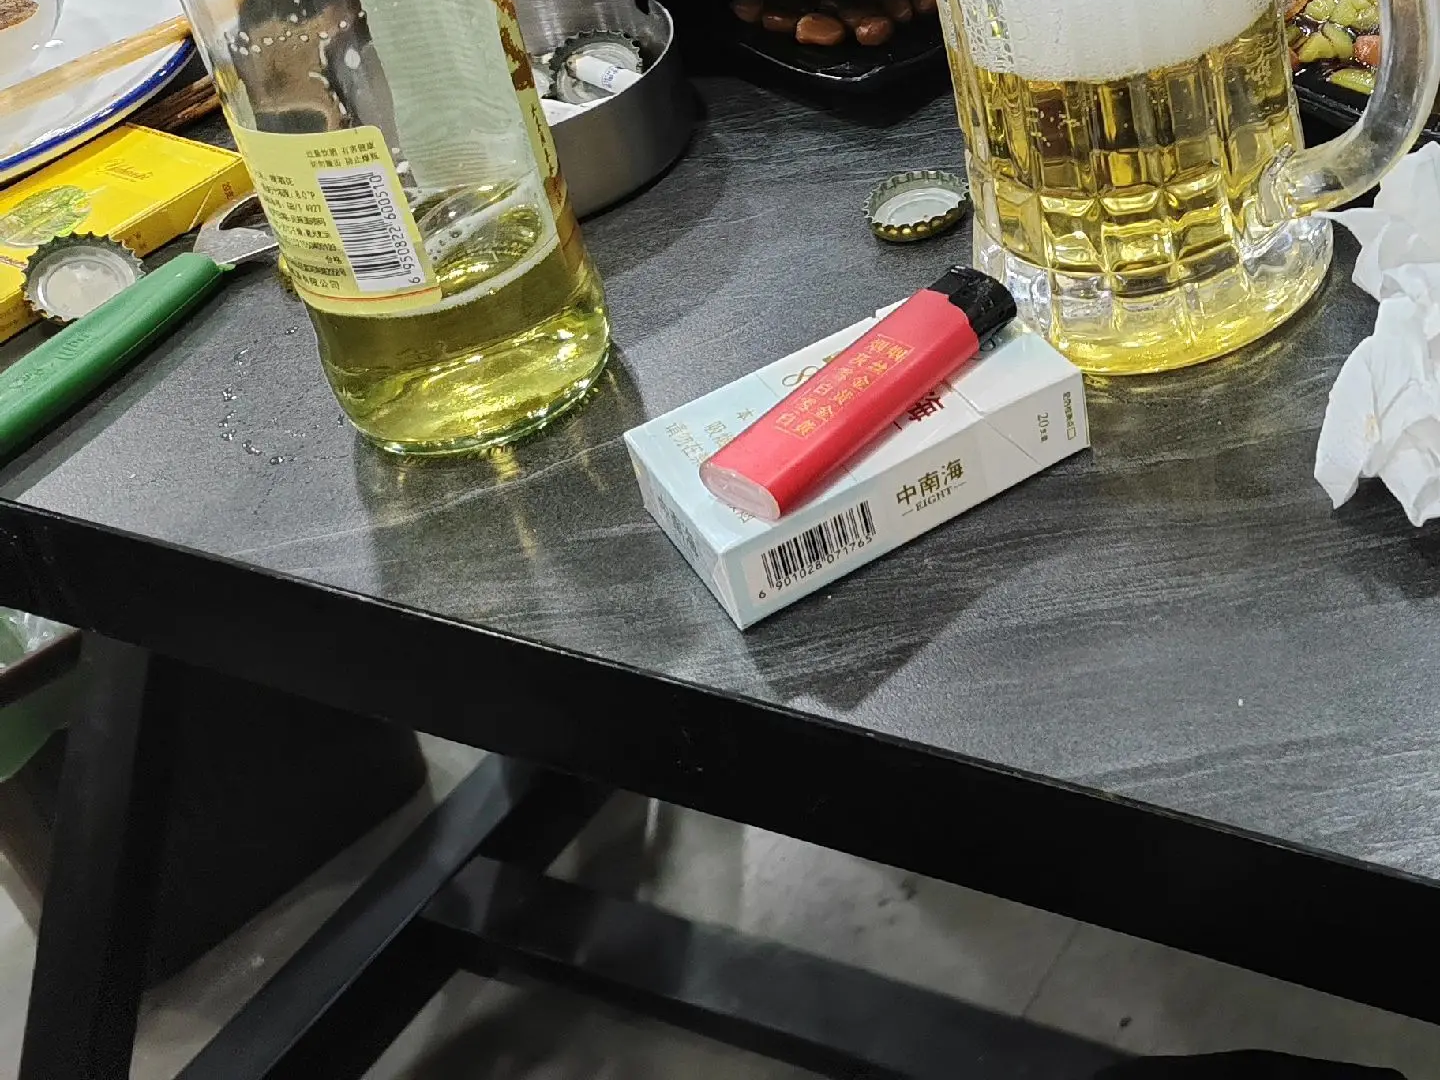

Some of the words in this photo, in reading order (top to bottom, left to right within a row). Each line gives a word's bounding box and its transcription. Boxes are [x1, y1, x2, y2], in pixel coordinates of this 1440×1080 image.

[896, 458, 964, 504] 中南海
[915, 486, 952, 512] EIGHT
